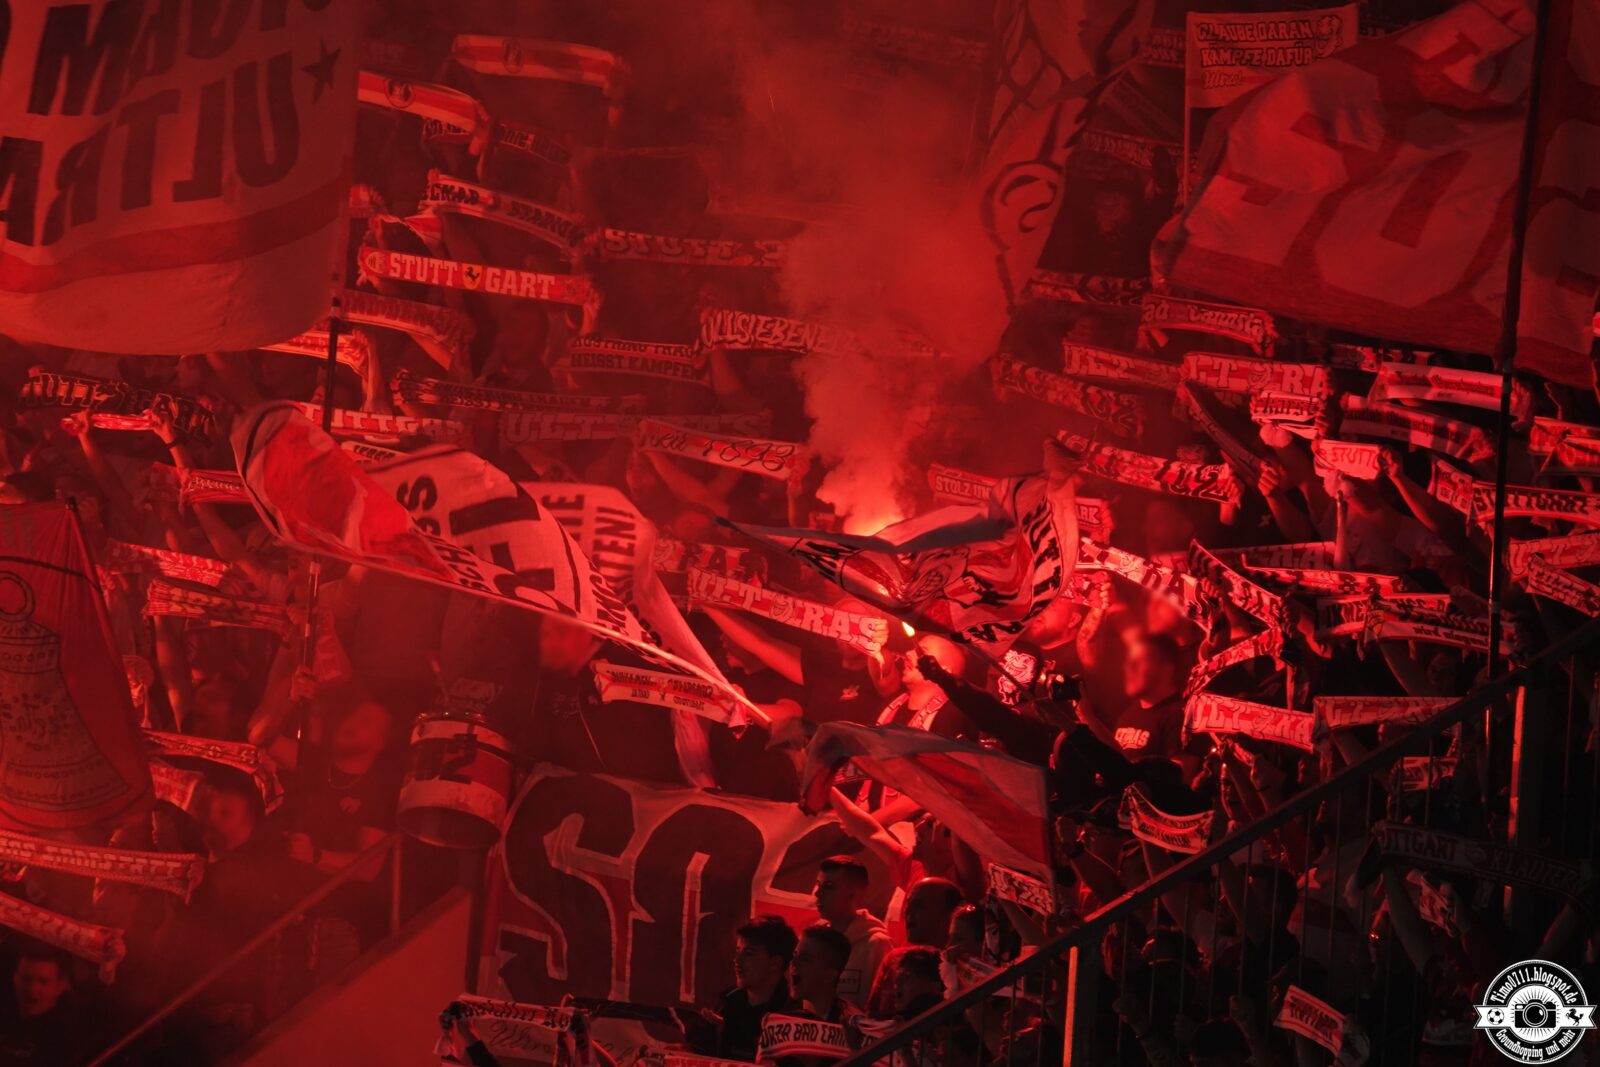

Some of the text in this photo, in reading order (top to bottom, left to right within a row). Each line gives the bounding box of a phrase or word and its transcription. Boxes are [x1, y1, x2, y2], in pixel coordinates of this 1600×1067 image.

[1256, 19, 1314, 41] DARAN
[1265, 41, 1314, 67] DAFÜR
[387, 255, 558, 300] STUTT GART
[571, 352, 624, 370] HEISST
[934, 474, 973, 497] STOLZ
[974, 480, 992, 500] UN
[761, 1022, 793, 1050] ORZA
[794, 1020, 820, 1043] BAD
